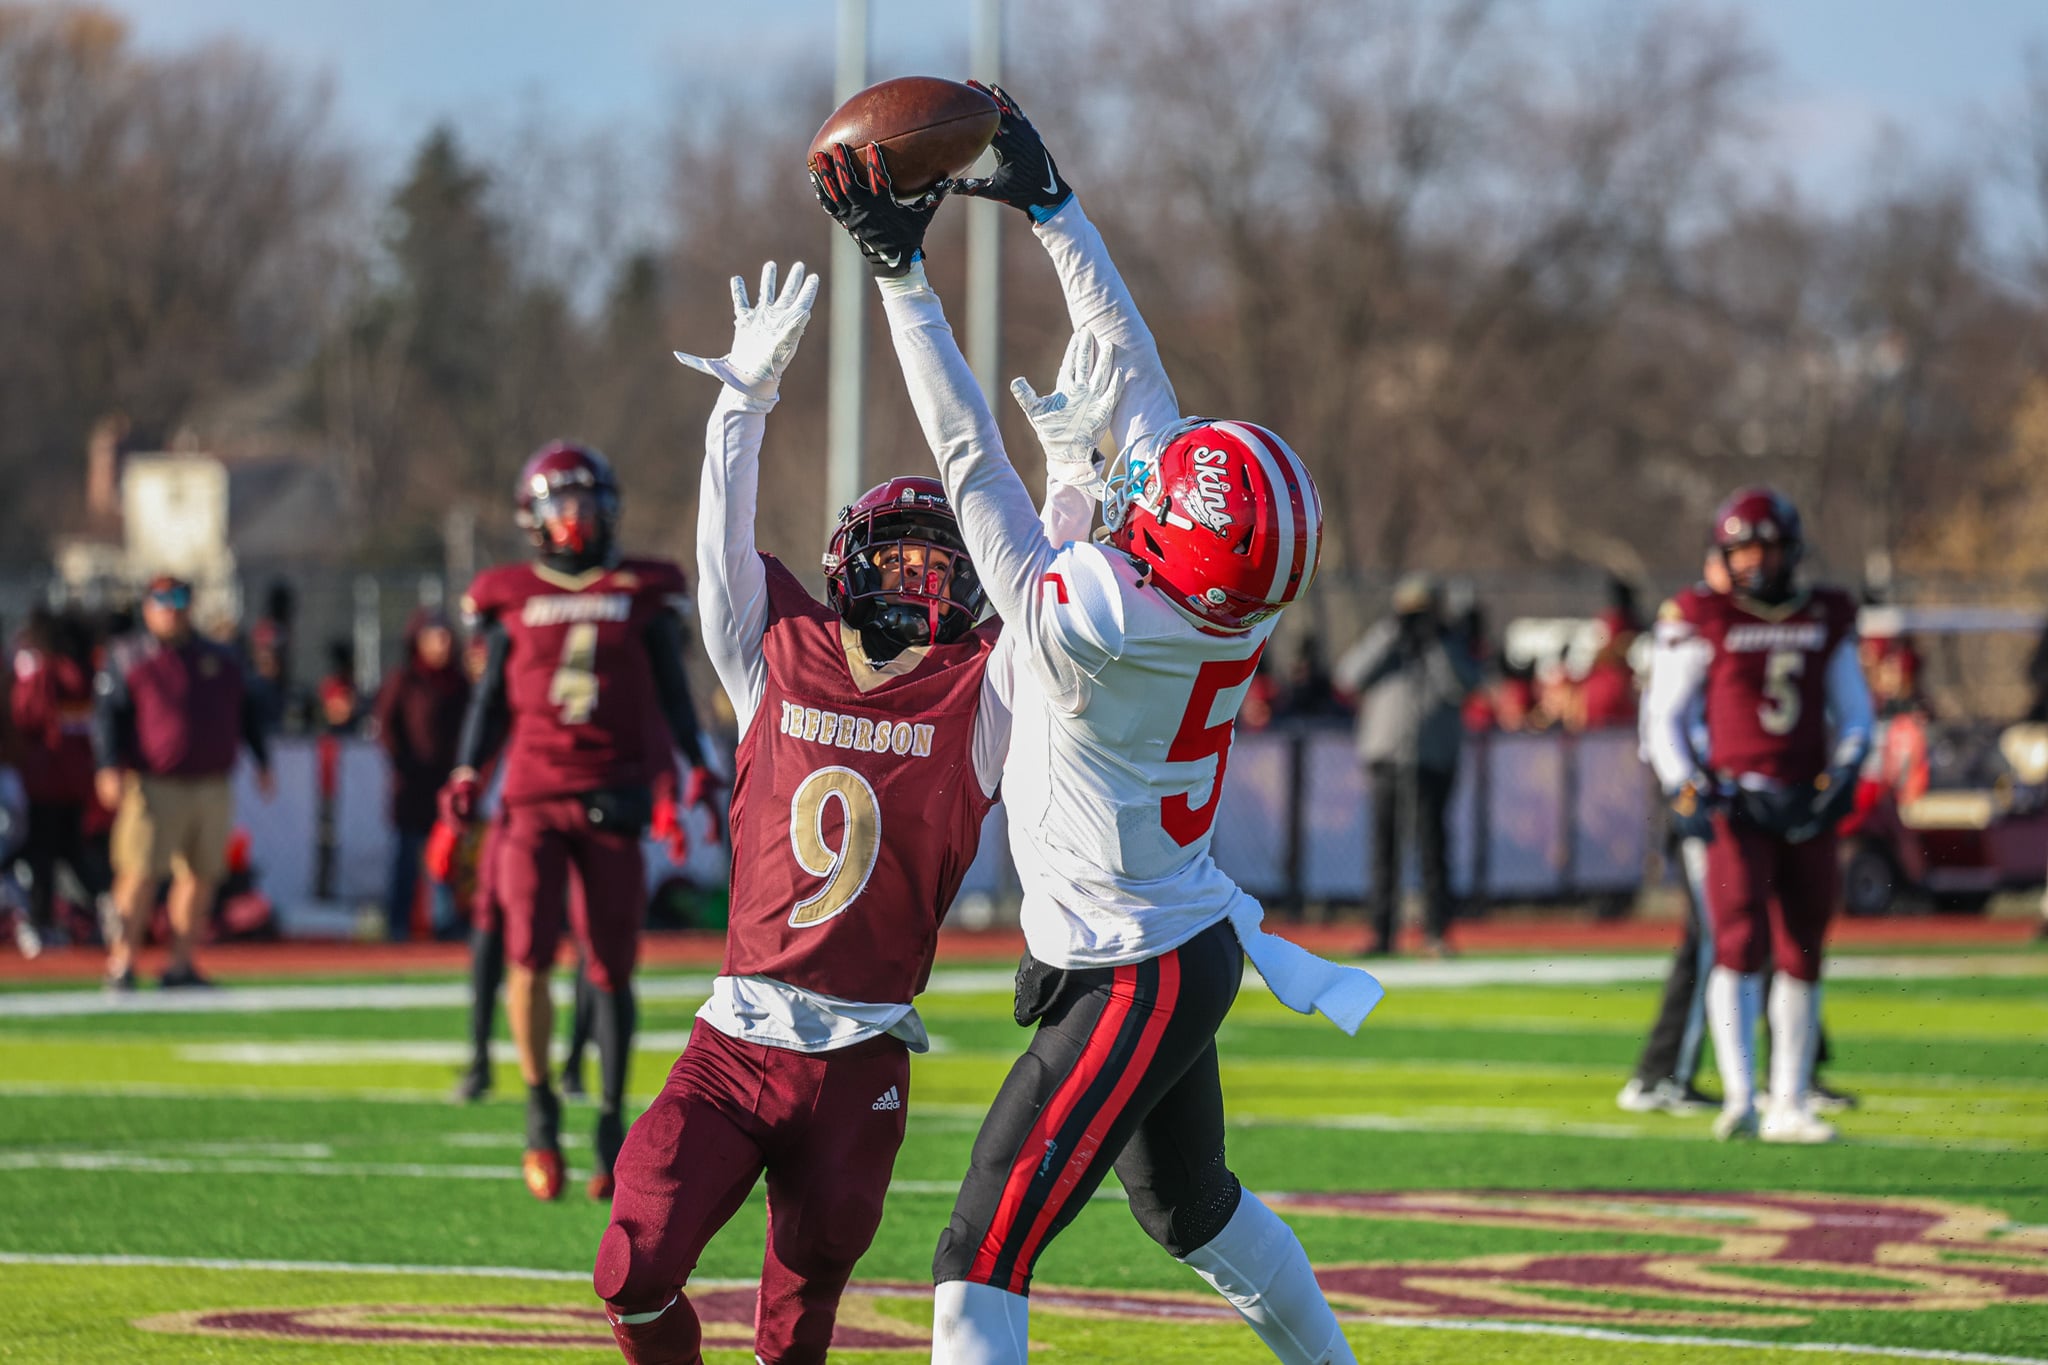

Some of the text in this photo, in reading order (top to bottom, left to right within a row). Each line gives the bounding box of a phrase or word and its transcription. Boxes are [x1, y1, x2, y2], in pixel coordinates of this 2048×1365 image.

[1194, 446, 1234, 531] Skins
[550, 626, 598, 724] 4
[1757, 653, 1804, 735] 5
[780, 700, 935, 757] JEFFERSON
[1160, 637, 1267, 847] 5
[789, 766, 882, 928] 9
